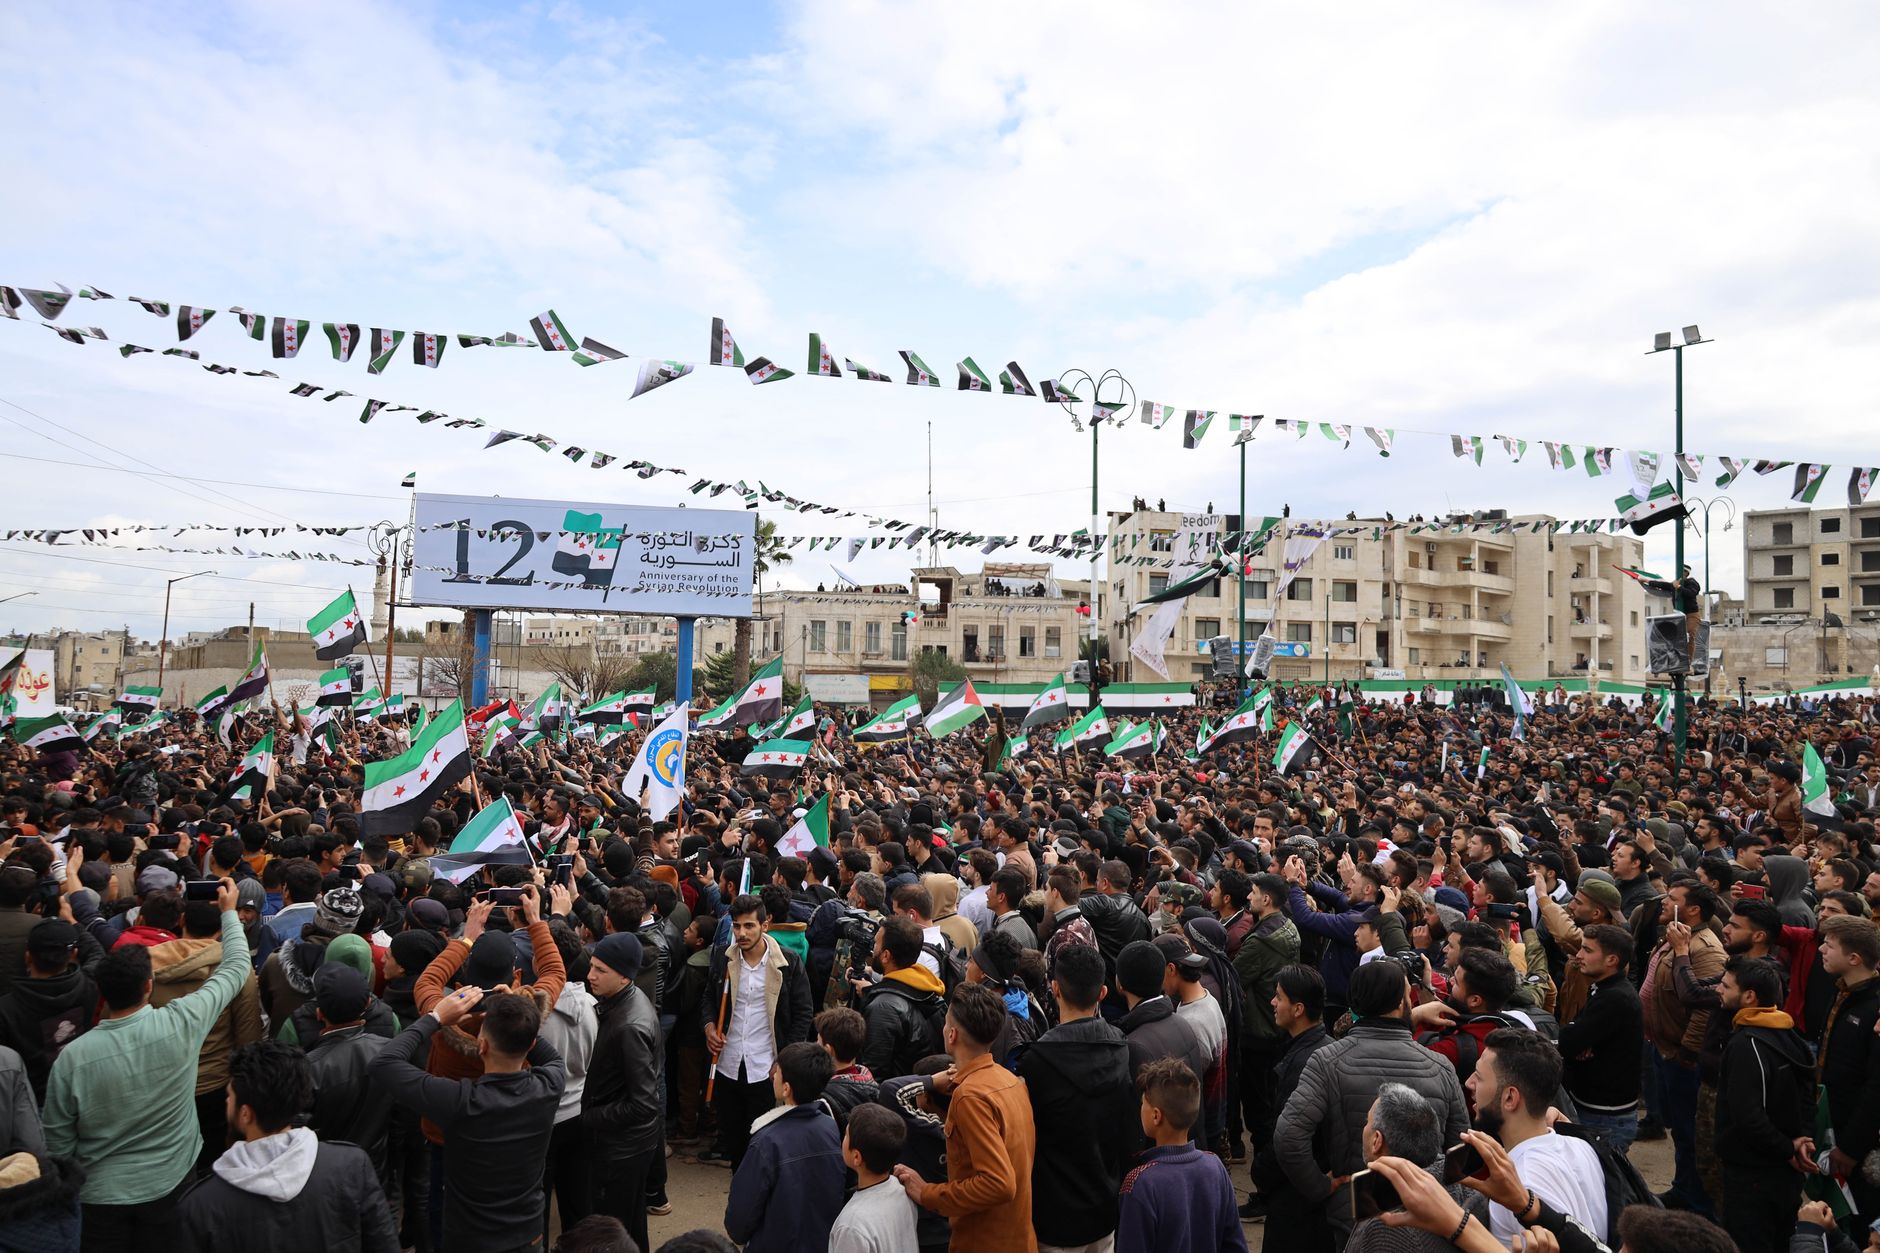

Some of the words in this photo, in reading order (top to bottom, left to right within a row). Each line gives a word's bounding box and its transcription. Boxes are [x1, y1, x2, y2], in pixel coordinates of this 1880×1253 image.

[650, 375, 661, 385] 12
[1180, 513, 1220, 528] eedom
[442, 518, 535, 586] 12
[640, 547, 740, 569] السورية
[639, 571, 703, 583] Anniversary
[707, 574, 718, 582] of
[721, 574, 739, 583] the
[638, 581, 674, 590] Syrian
[678, 582, 739, 592] Revolution
